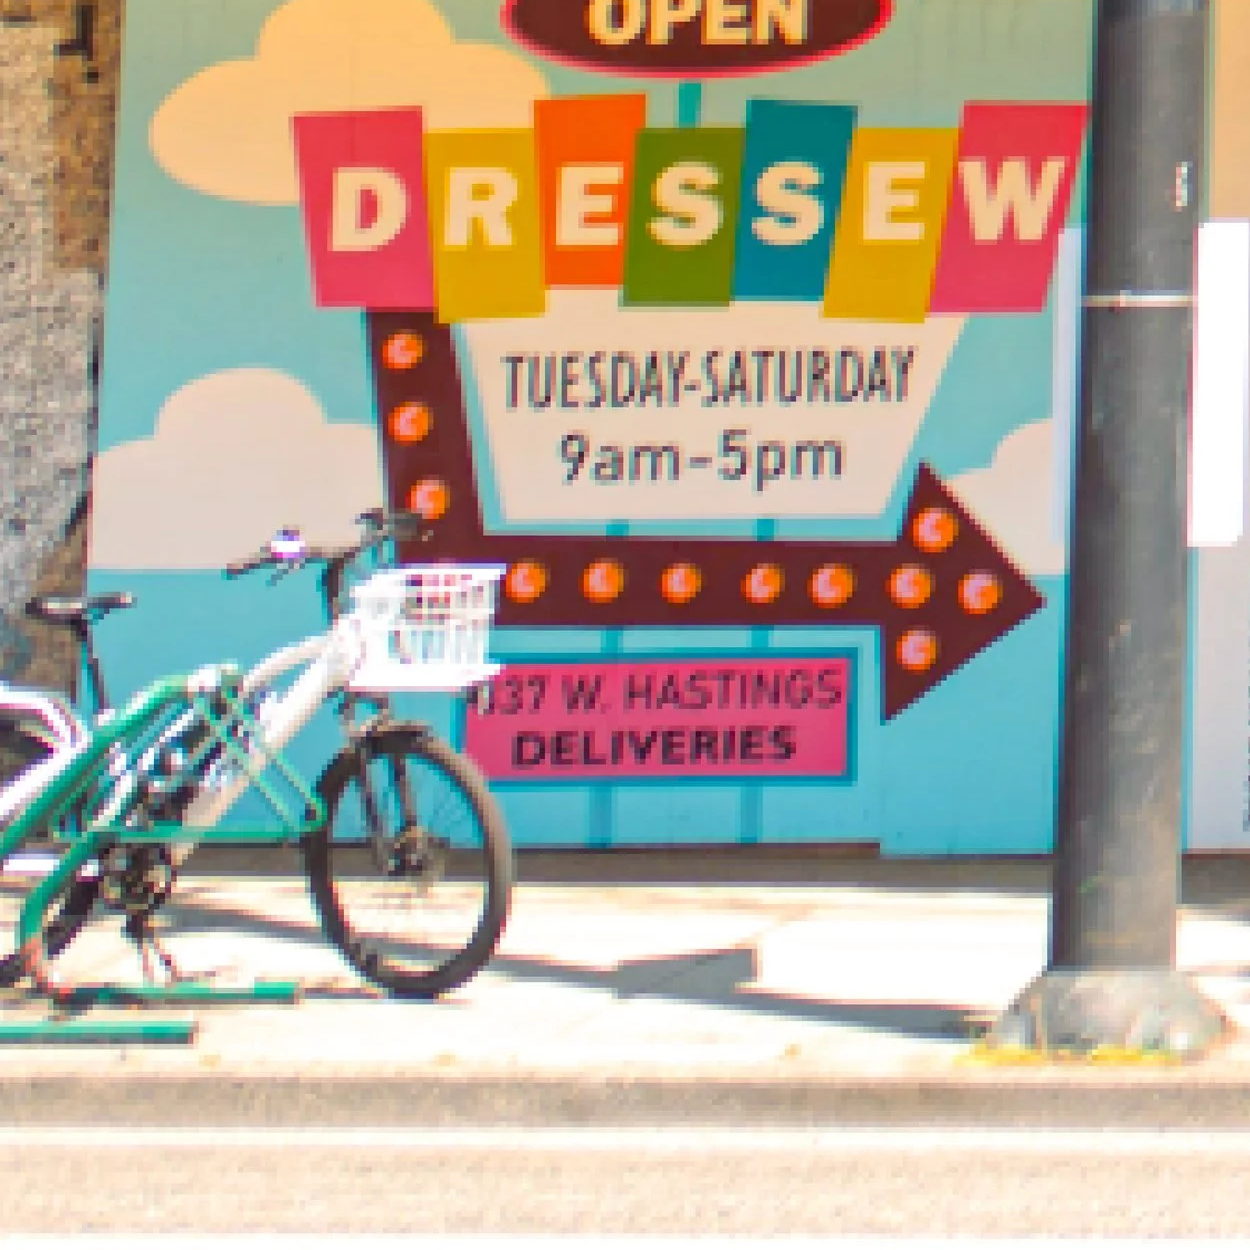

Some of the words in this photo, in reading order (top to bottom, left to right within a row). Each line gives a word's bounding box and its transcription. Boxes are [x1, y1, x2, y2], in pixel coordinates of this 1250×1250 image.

[327, 156, 1067, 253] DRESSEW
[500, 346, 918, 412] TUESDAY-SATURDAY
[486, 673, 551, 715] 37
[622, 667, 842, 711] HASTINGS
[510, 724, 798, 771] DELIVERIES
